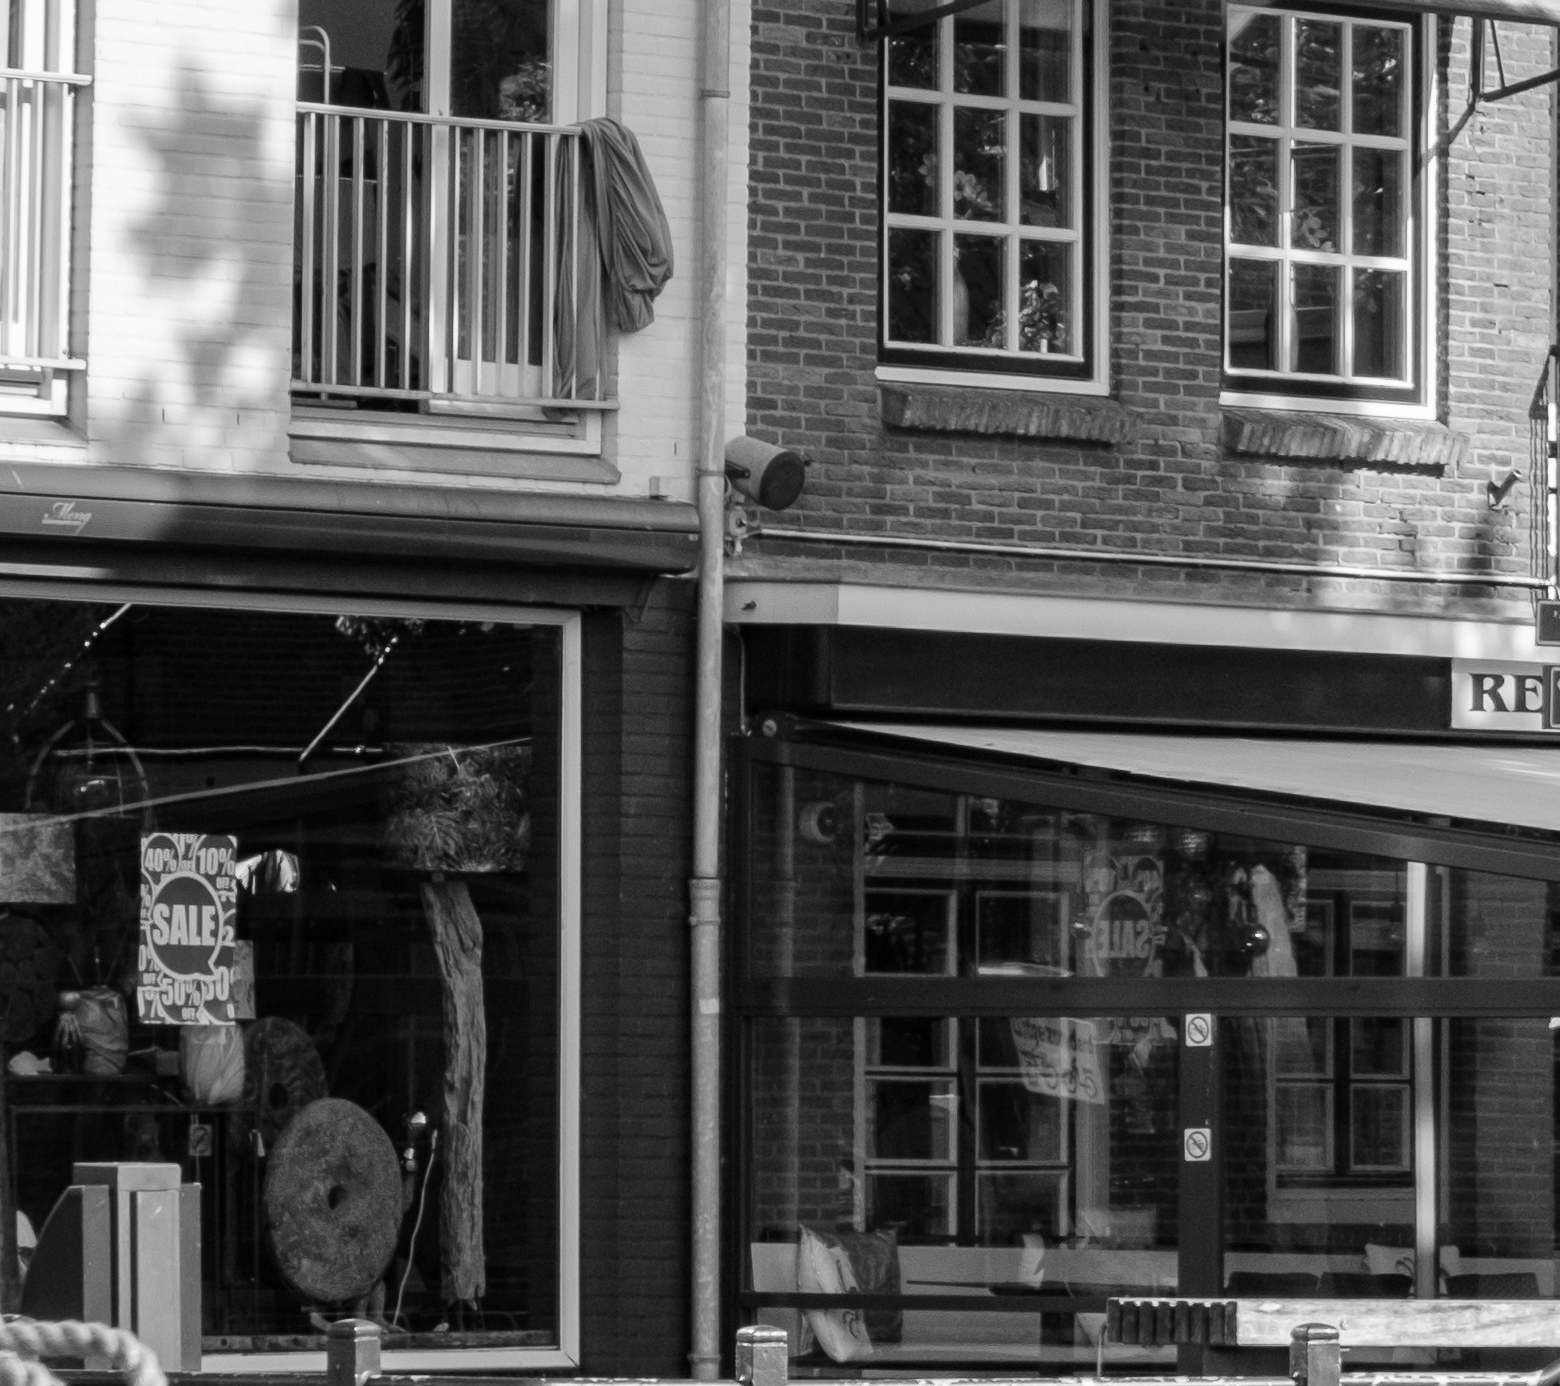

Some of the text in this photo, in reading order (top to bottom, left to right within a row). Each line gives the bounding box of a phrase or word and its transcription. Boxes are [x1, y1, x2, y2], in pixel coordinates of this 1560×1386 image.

[145, 847, 236, 875] 40% 10%
[152, 903, 217, 947] SALE
